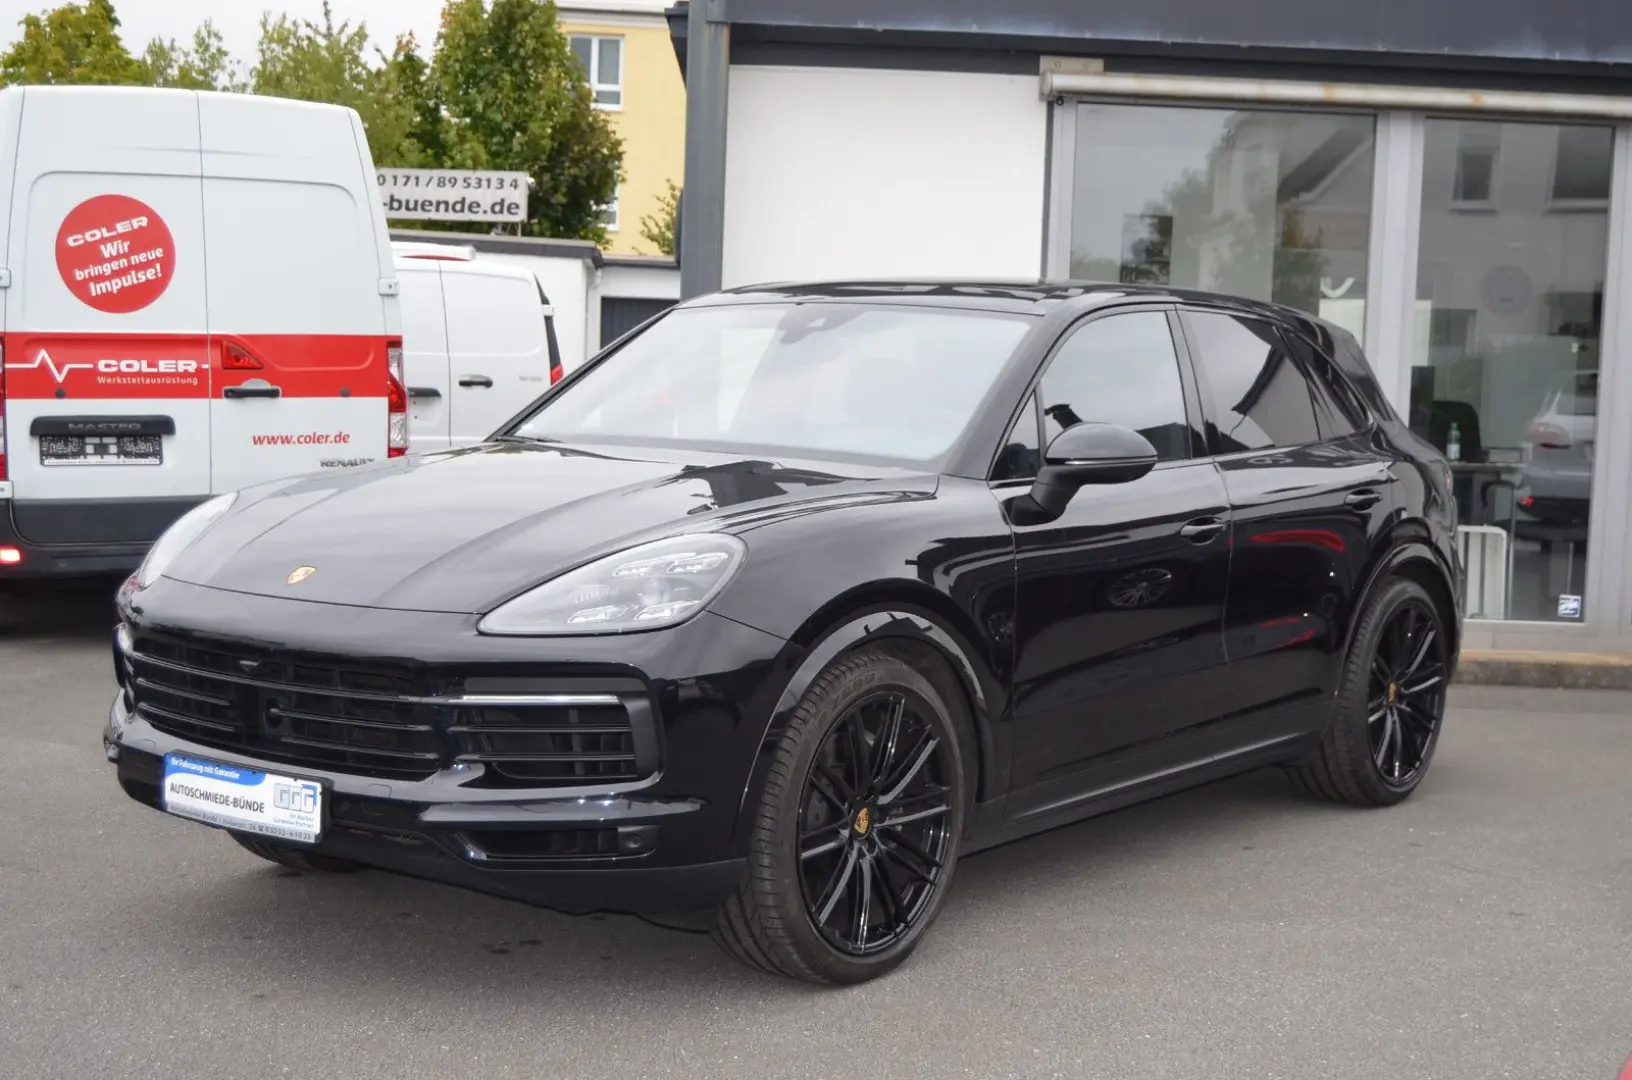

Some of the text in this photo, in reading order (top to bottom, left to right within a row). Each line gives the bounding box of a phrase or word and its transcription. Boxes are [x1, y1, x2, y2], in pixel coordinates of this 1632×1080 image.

[67, 215, 149, 247] COLER
[100, 240, 131, 258] Wir
[74, 248, 164, 281] bringen neue
[89, 262, 162, 297] Impulse!
[98, 359, 198, 373] COLER
[97, 375, 198, 386] Werkstattausrüstung
[252, 431, 351, 445] www.coler.de
[170, 782, 265, 813] AUTOSCHMIEDE-BÜNDE
